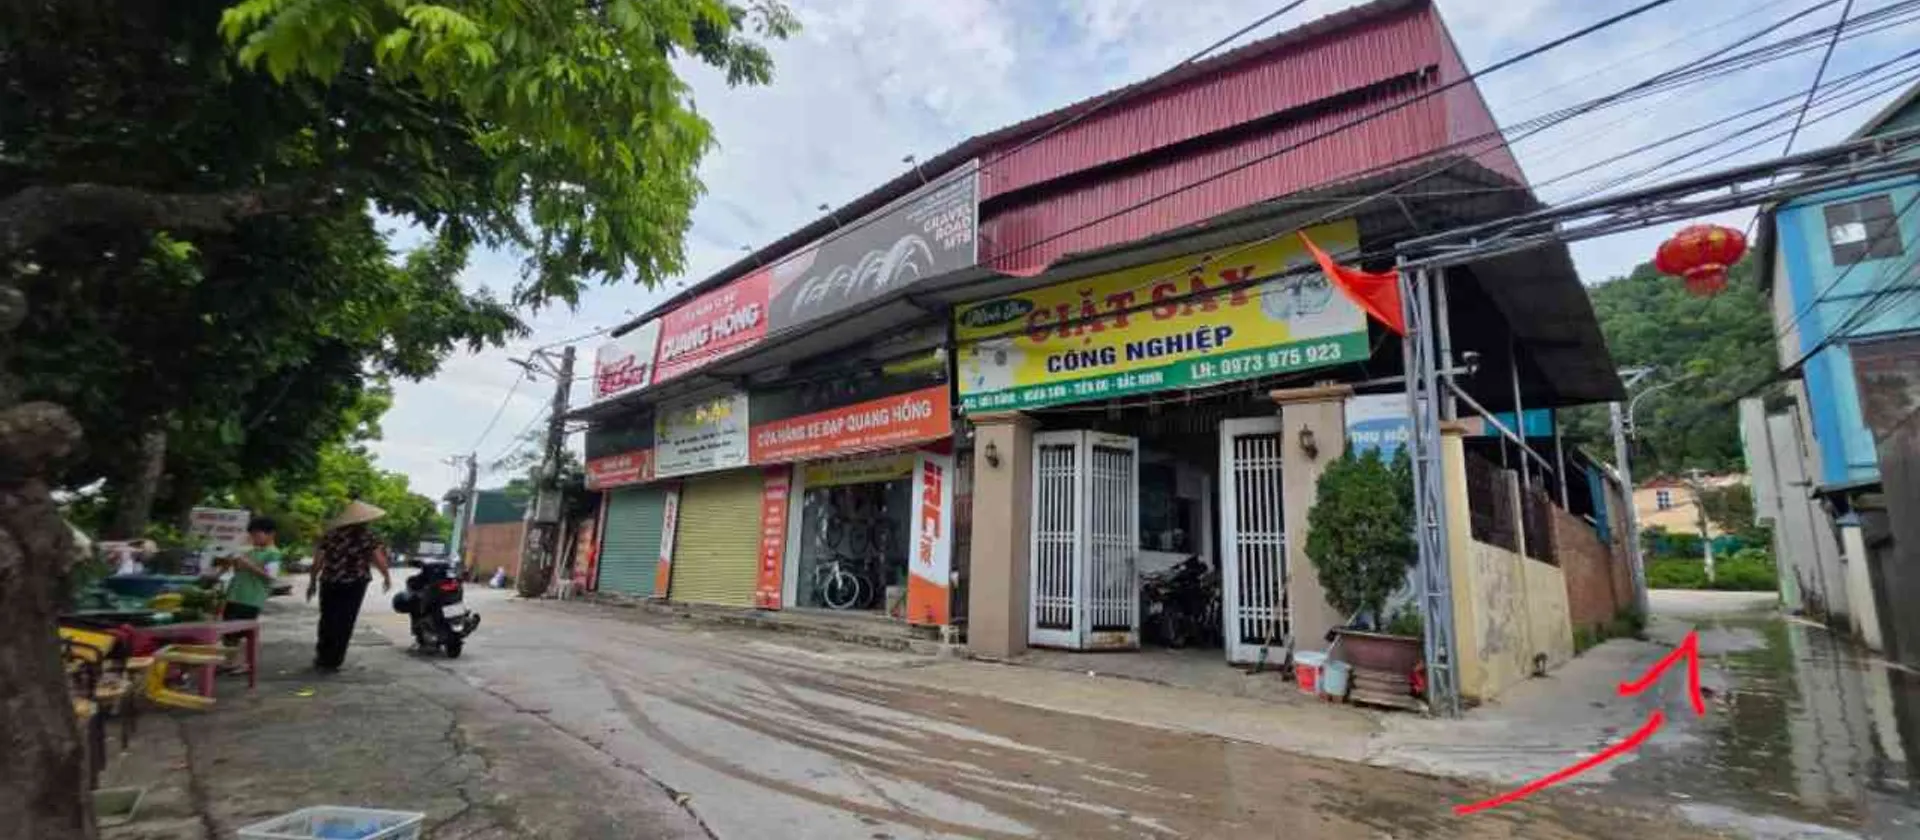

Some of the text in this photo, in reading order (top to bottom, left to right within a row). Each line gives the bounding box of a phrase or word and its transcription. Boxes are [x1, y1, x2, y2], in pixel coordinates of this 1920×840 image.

[936, 216, 972, 242] ROAD
[944, 229, 972, 251] MTB
[1025, 254, 1256, 346] GIẶT SẤY
[661, 324, 711, 360] QUANG
[1047, 324, 1234, 374] CÔNG NGHIỆP
[1190, 342, 1342, 381] LH: 0973 975 923
[845, 409, 889, 432] QUANG
